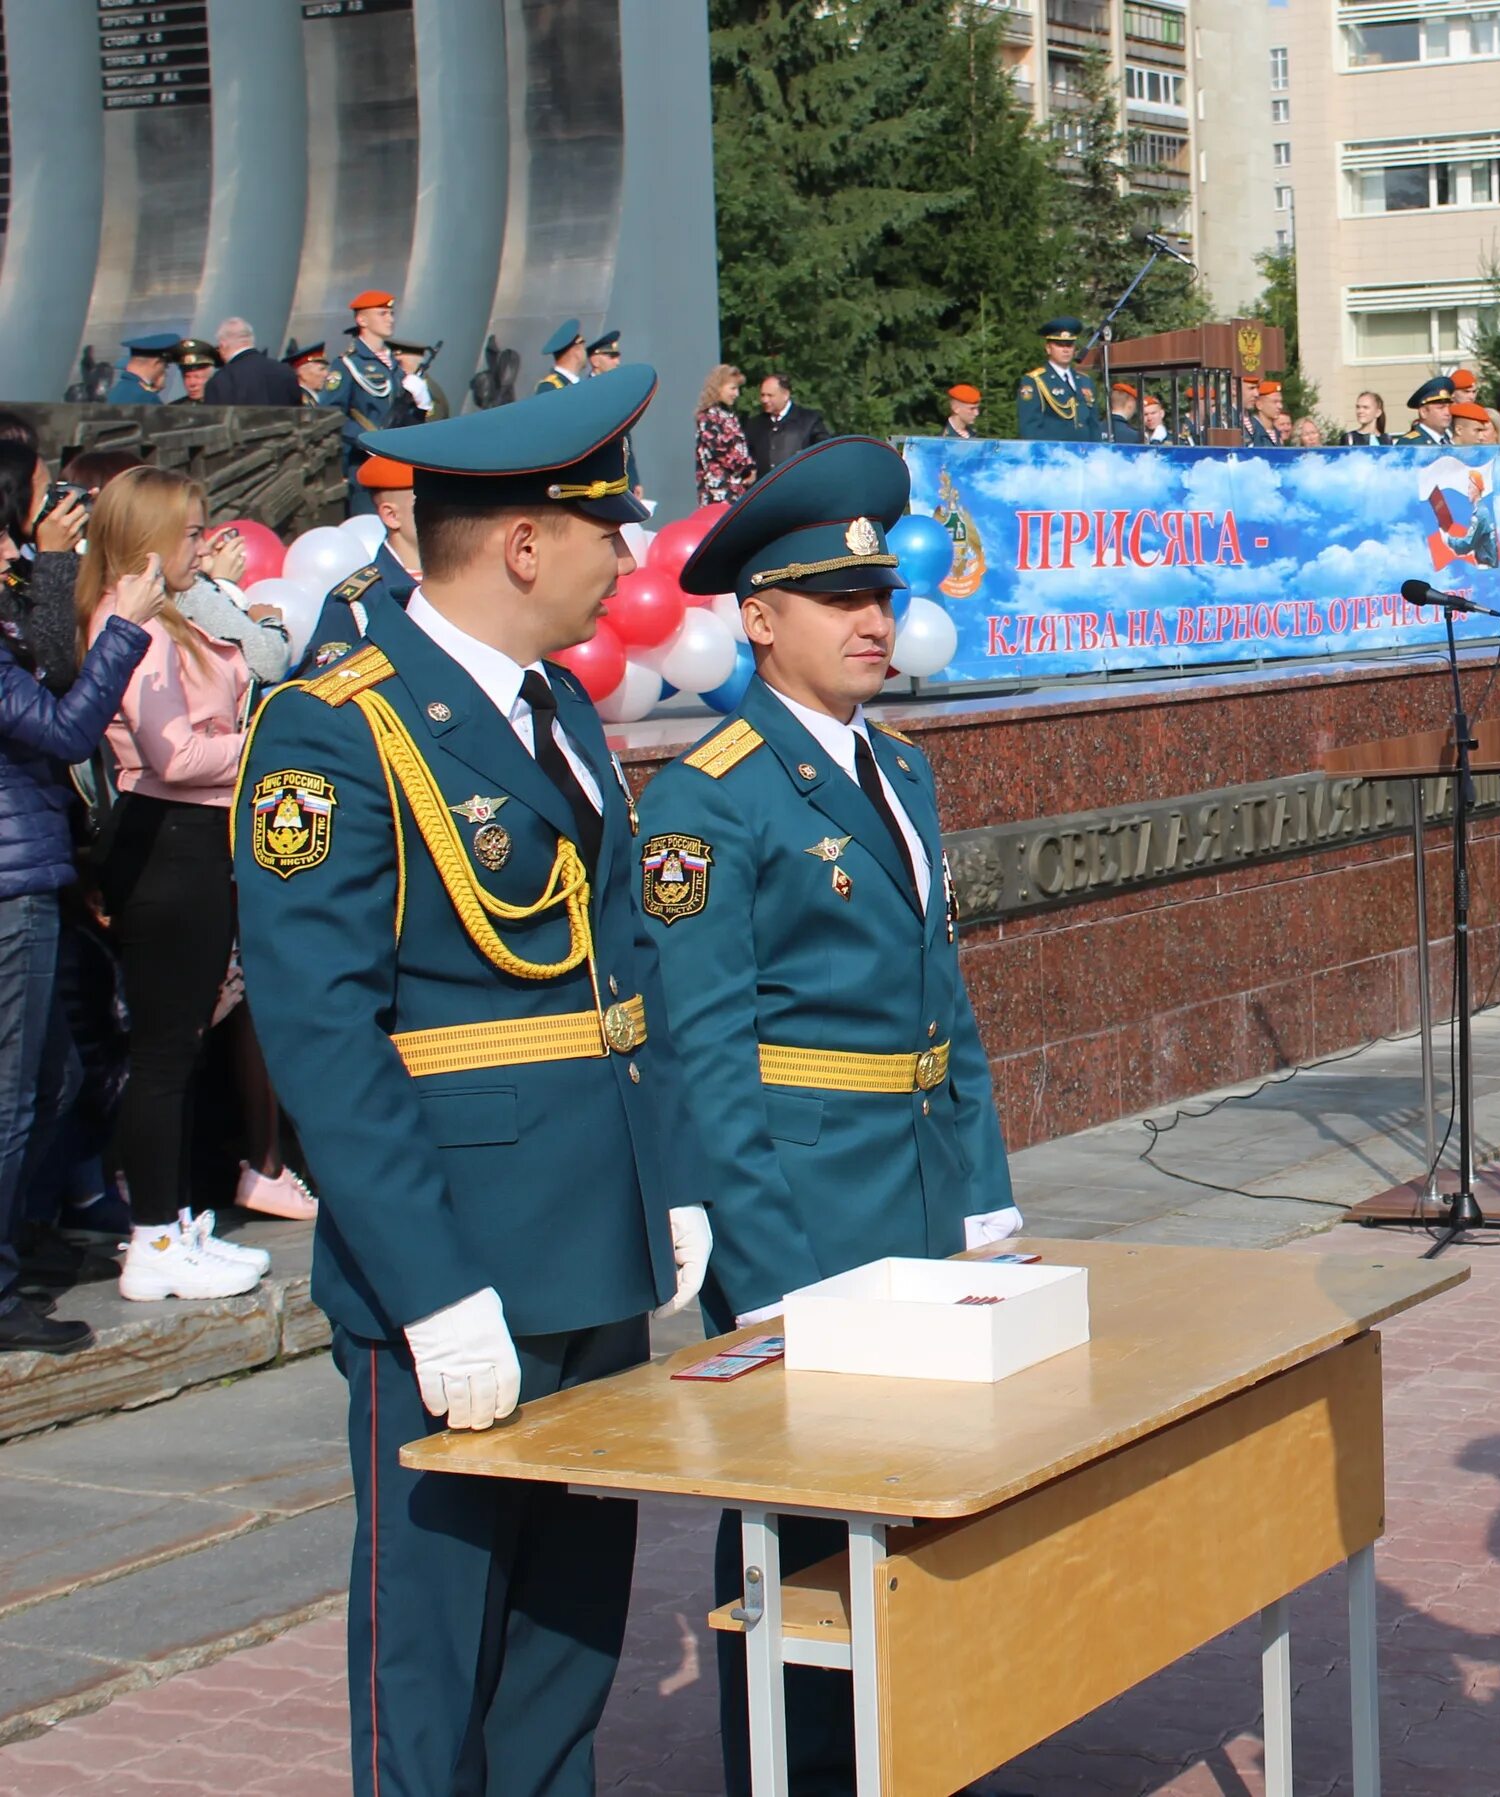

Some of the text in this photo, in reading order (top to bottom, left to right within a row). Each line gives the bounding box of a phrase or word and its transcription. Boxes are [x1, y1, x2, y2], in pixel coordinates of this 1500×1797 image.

[1015, 508, 1247, 572] ПРИСЯГА
[986, 611, 1119, 657] КЛЯТВА
[1127, 608, 1168, 647] НА
[1175, 600, 1323, 645] ВЕРНОСТЬ
[265, 773, 321, 790] МЧС РОССИИ
[280, 840, 324, 866] ИНСТИТУТ
[317, 816, 326, 835] ГПС
[667, 837, 698, 853] РОССИИ
